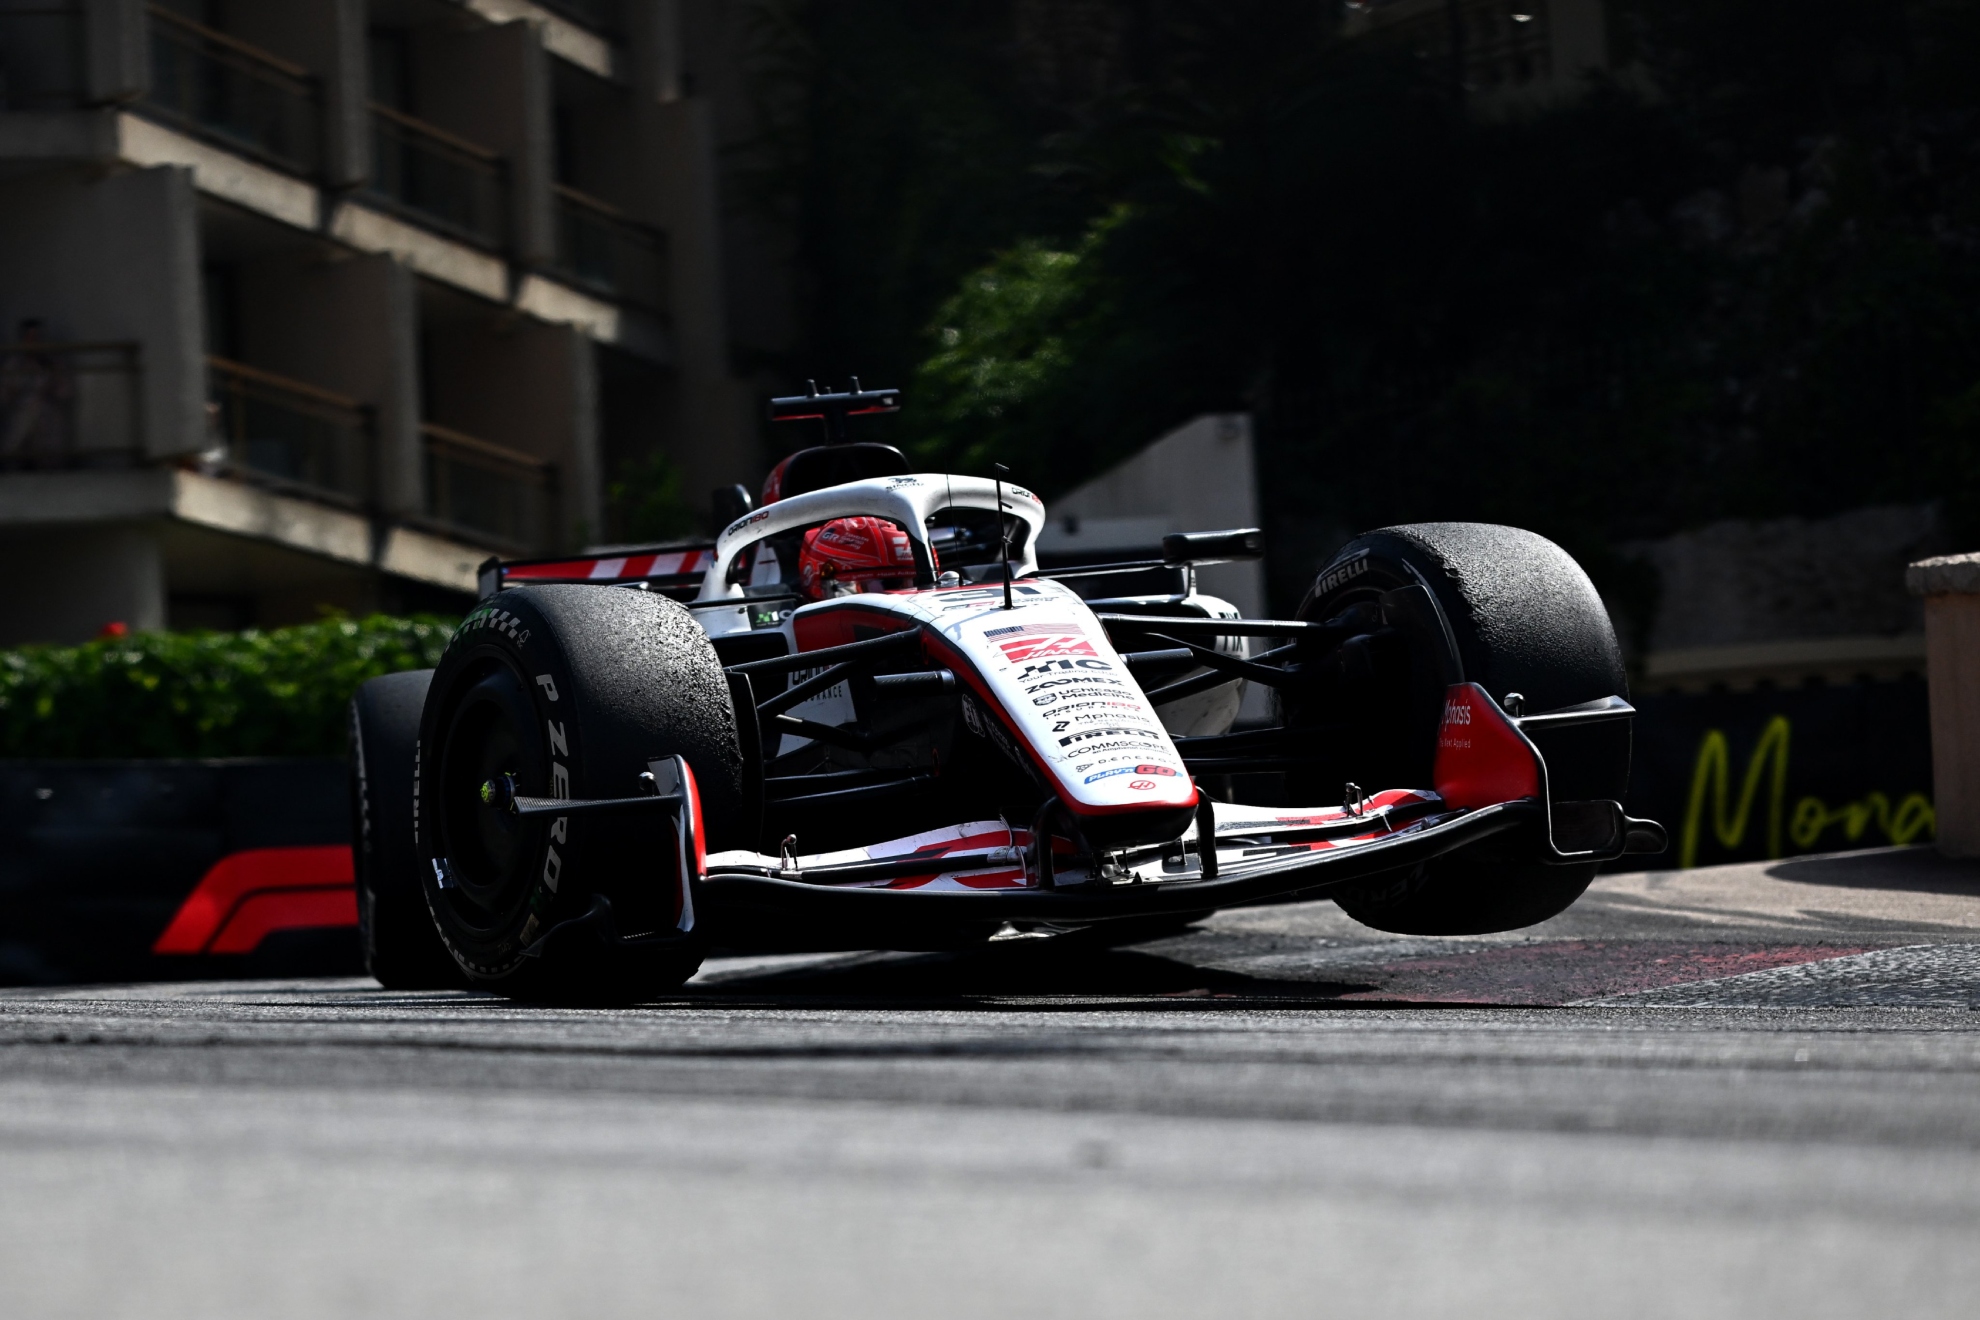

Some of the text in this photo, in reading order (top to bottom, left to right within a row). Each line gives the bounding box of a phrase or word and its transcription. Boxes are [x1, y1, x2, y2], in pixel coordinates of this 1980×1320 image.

[1315, 548, 1370, 598] PIRELLI
[1074, 712, 1151, 723] Mphasis
[1058, 727, 1160, 748] PIRELLI
[1067, 740, 1170, 759] COMMSCOPE
[536, 674, 570, 894] P ZERO
